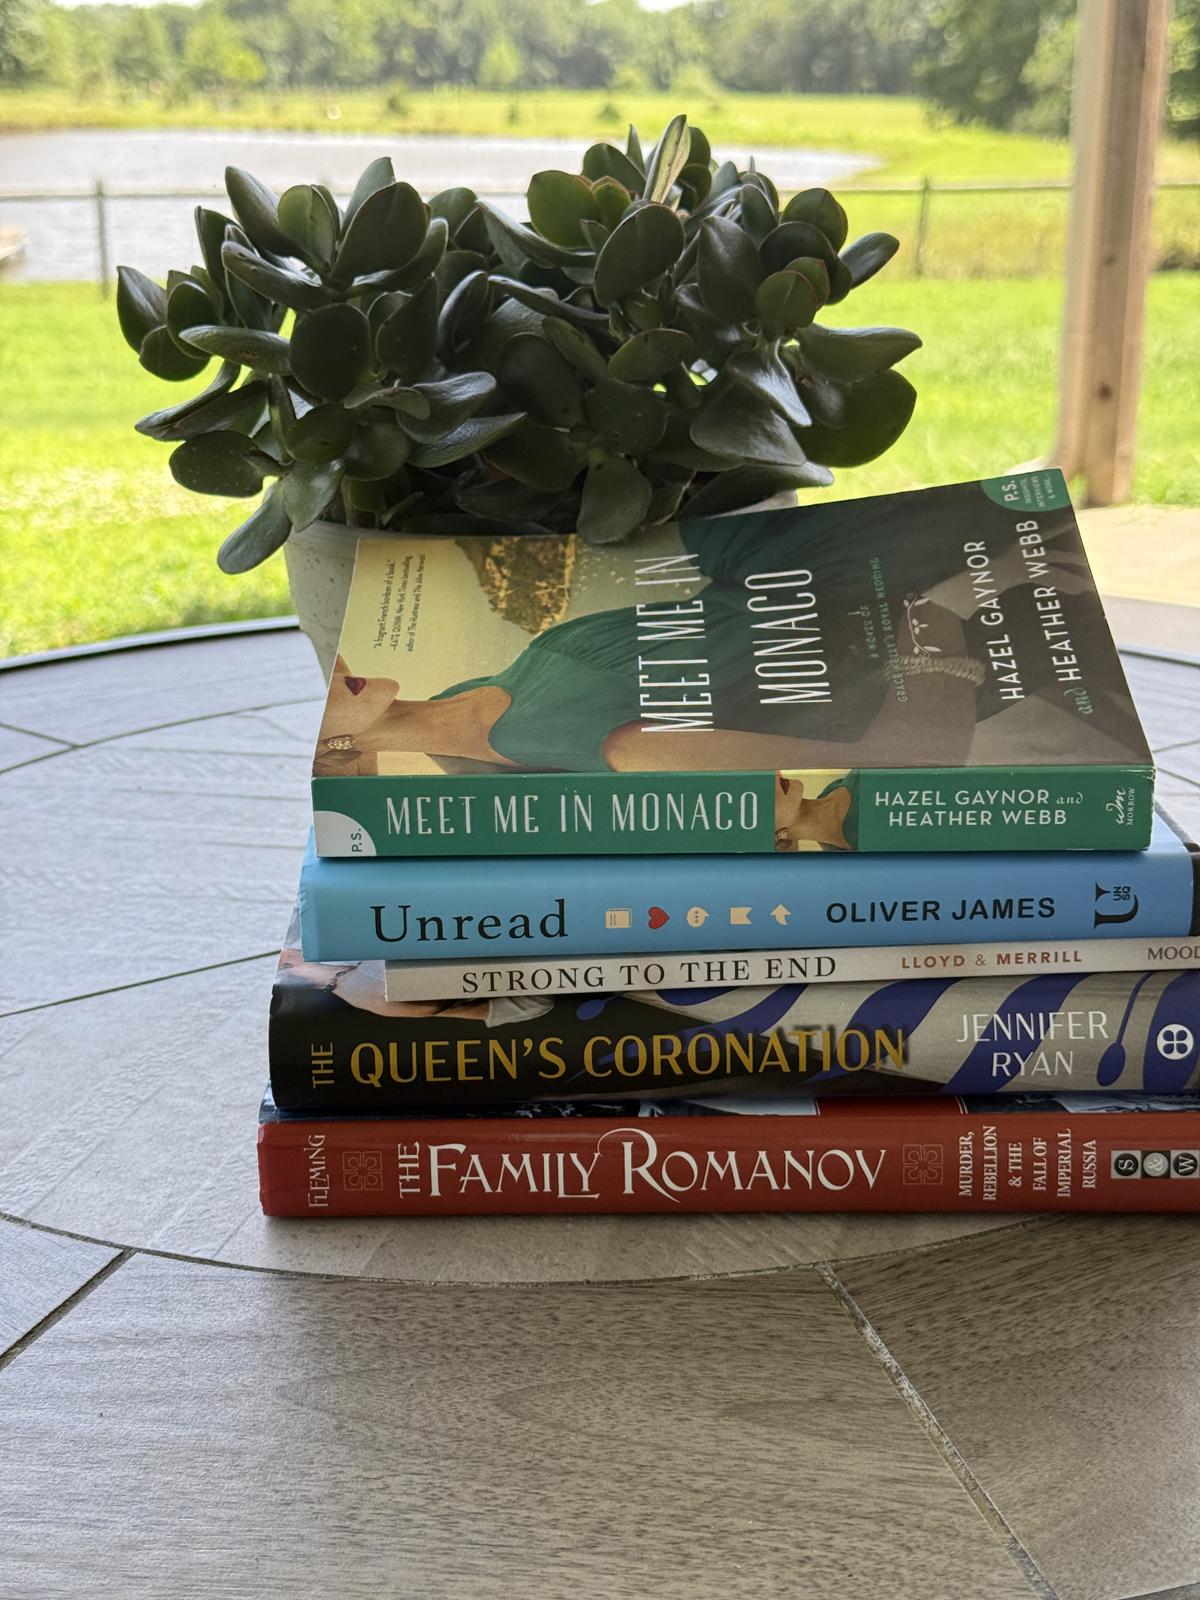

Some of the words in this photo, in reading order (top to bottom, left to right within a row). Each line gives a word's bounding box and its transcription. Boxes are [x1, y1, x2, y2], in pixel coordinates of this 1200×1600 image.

[1002, 480, 1020, 502] P.S.
[1016, 520, 1050, 579] WEBB
[635, 554, 701, 585] IN
[963, 541, 1004, 626] GAYNOR
[636, 600, 706, 640] ME
[745, 569, 832, 704] MONACO
[1034, 586, 1082, 681] HEATHER
[986, 634, 1025, 700] HAZEL
[638, 656, 714, 732] MEET
[892, 673, 908, 703] GRACE
[1064, 687, 1093, 715] and
[387, 796, 476, 834] MEET
[494, 795, 539, 833] ME
[560, 794, 592, 832] IN
[612, 791, 758, 832] MONACO
[875, 790, 946, 806] HAZEL
[955, 789, 1049, 806] GAYNOR
[1056, 791, 1084, 805] and
[1127, 788, 1136, 825] MORROW
[889, 810, 992, 827] HEATHER
[1002, 809, 1067, 825] WEBB
[351, 828, 363, 852] P.S.
[370, 898, 568, 944] Unread
[826, 900, 940, 923] OLIVER
[951, 896, 1056, 921] JAMES
[462, 966, 604, 994] STRONG
[619, 963, 665, 986] TO
[680, 958, 750, 982] THE
[765, 955, 836, 979] END
[901, 953, 966, 969] LLOYD
[975, 953, 986, 967] &
[996, 949, 1082, 965] MERRILL
[956, 1010, 1109, 1043] JENNIFER
[311, 1042, 334, 1088] THE
[350, 1036, 566, 1088] QUEEN'S
[584, 1028, 905, 1078] CORONATION
[992, 1051, 1074, 1078] RYAN
[398, 1141, 421, 1198] THE
[428, 1143, 600, 1199] FAMILY
[597, 1128, 887, 1203] ROMANOV
[958, 1131, 975, 1198] MURDER,
[982, 1125, 998, 1201] REBELLION
[1008, 1142, 1022, 1173] THE
[1032, 1136, 1047, 1157] OF
[1057, 1128, 1072, 1198] IMPERIAL
[1082, 1139, 1097, 1189] RUSSIA
[303, 1134, 329, 1208] FLEMING
[1008, 1174, 1022, 1188] &
[1032, 1157, 1047, 1191] FALL
